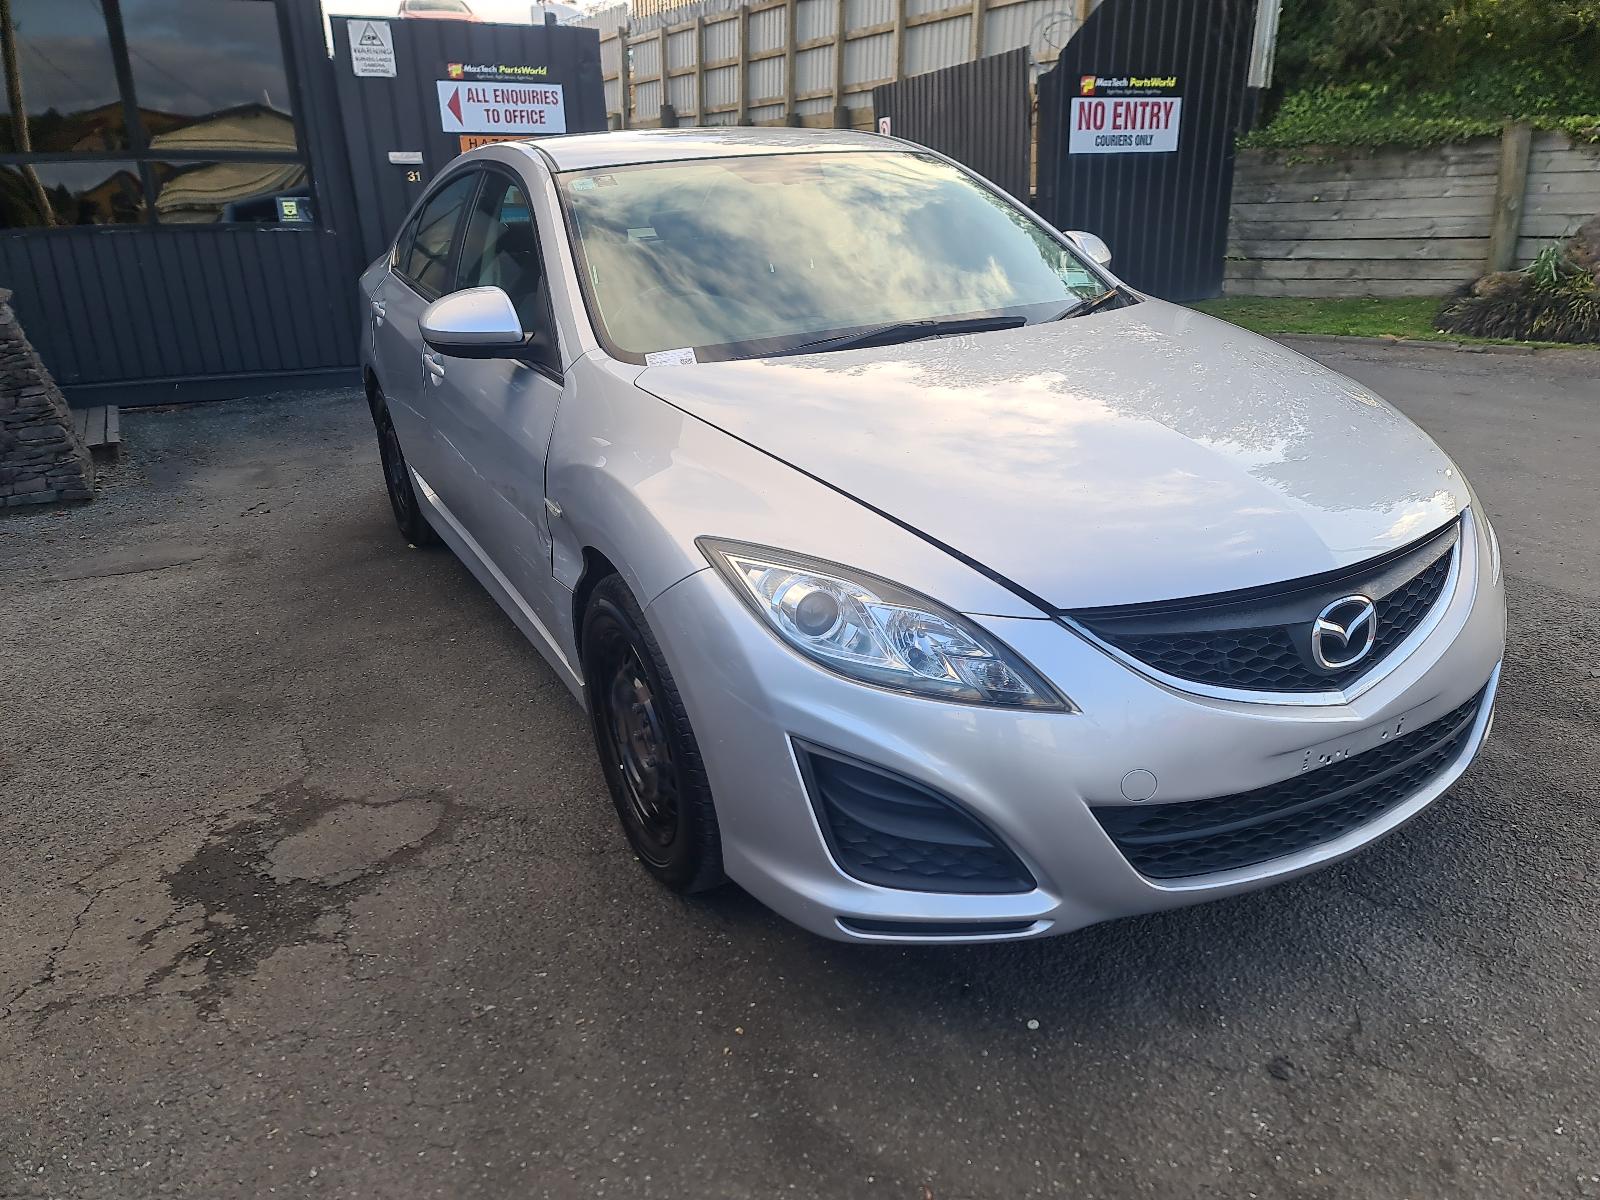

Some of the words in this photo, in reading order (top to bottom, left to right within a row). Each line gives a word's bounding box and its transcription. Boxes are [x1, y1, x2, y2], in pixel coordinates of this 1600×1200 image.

[353, 47, 393, 55] WARNING
[463, 64, 497, 73] MaxTech
[498, 65, 547, 75] PartsWorld
[1095, 77, 1129, 87] MaxTech
[1129, 76, 1176, 88] PartsWorld
[467, 87, 490, 103] ALL
[493, 88, 559, 106] ENQUIRIES
[484, 108, 500, 123] TO
[504, 109, 546, 125] OFFICE
[1077, 101, 1105, 131] NO
[1111, 101, 1174, 131] ENTRY
[1095, 134, 1133, 147] COURIERS
[1135, 134, 1154, 146] ONLY
[407, 171, 422, 182] 31
